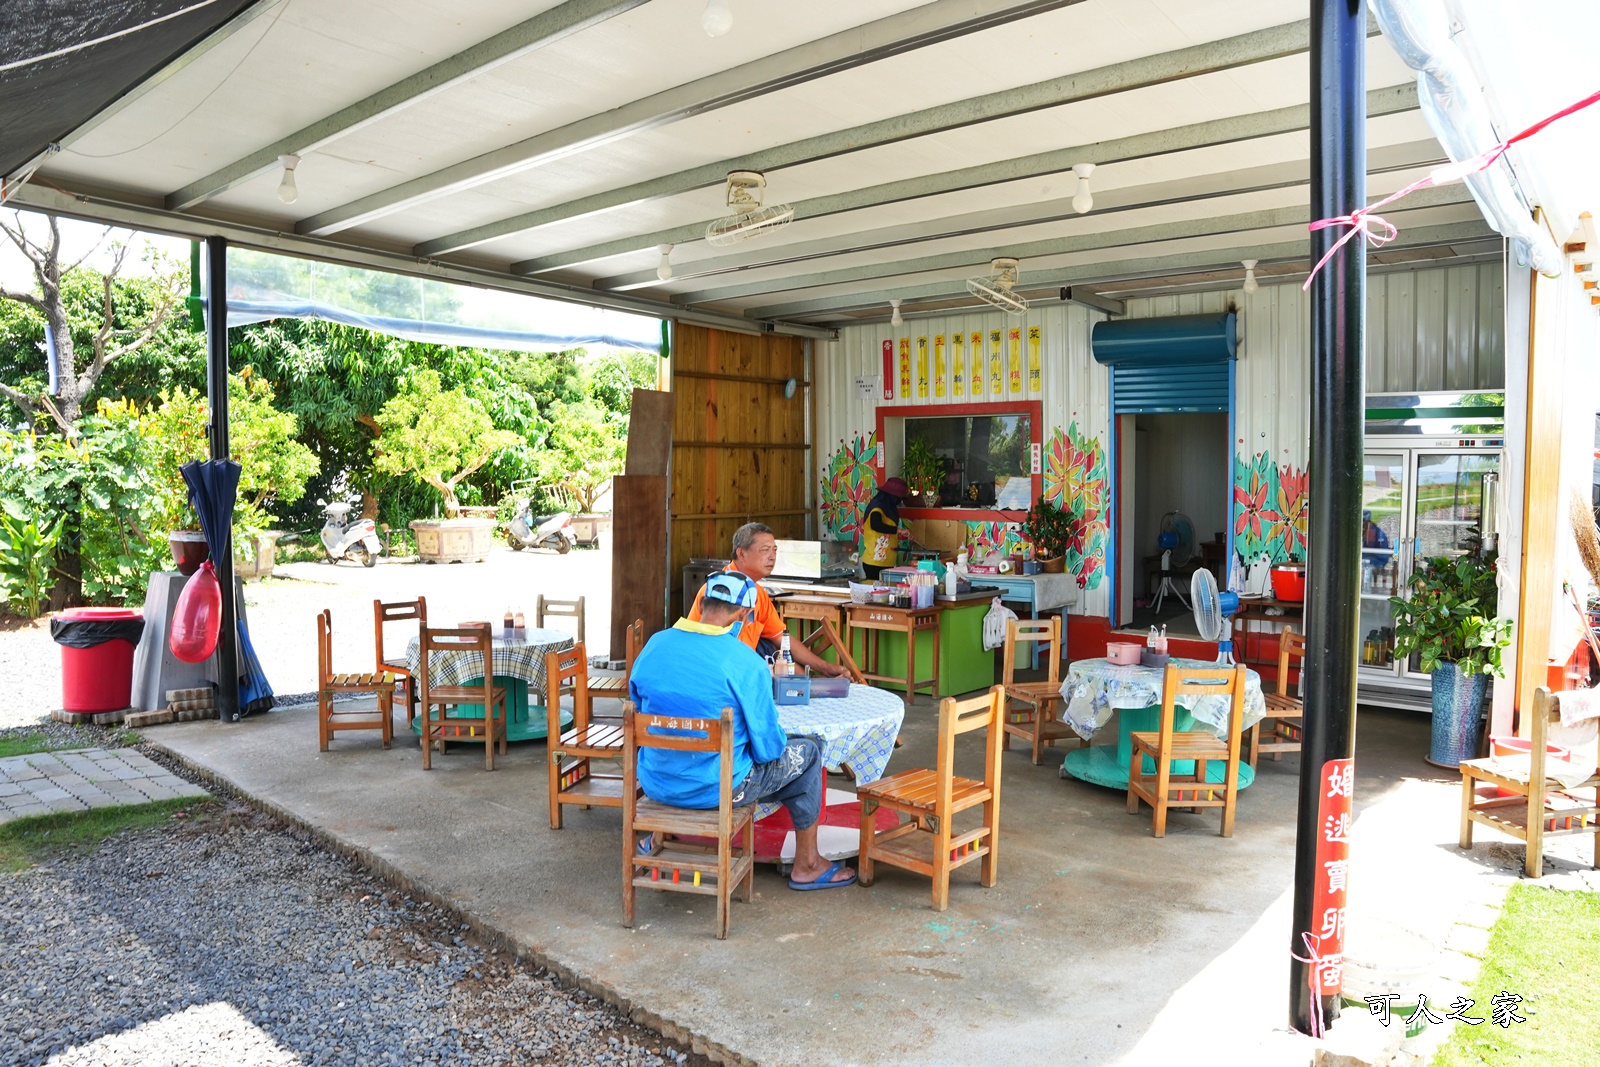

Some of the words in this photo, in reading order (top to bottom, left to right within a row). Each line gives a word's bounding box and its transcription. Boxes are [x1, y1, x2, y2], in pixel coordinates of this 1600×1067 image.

[883, 341, 893, 398] 香腸
[917, 338, 928, 385] 貢丸
[953, 335, 963, 383] 黑輪
[971, 334, 982, 382] 米血
[990, 332, 1001, 381] 福州丸
[1029, 329, 1040, 379] 菜頭
[650, 715, 709, 730] 山海國小
[1320, 764, 1354, 987] 婚逃賣卵蛋
